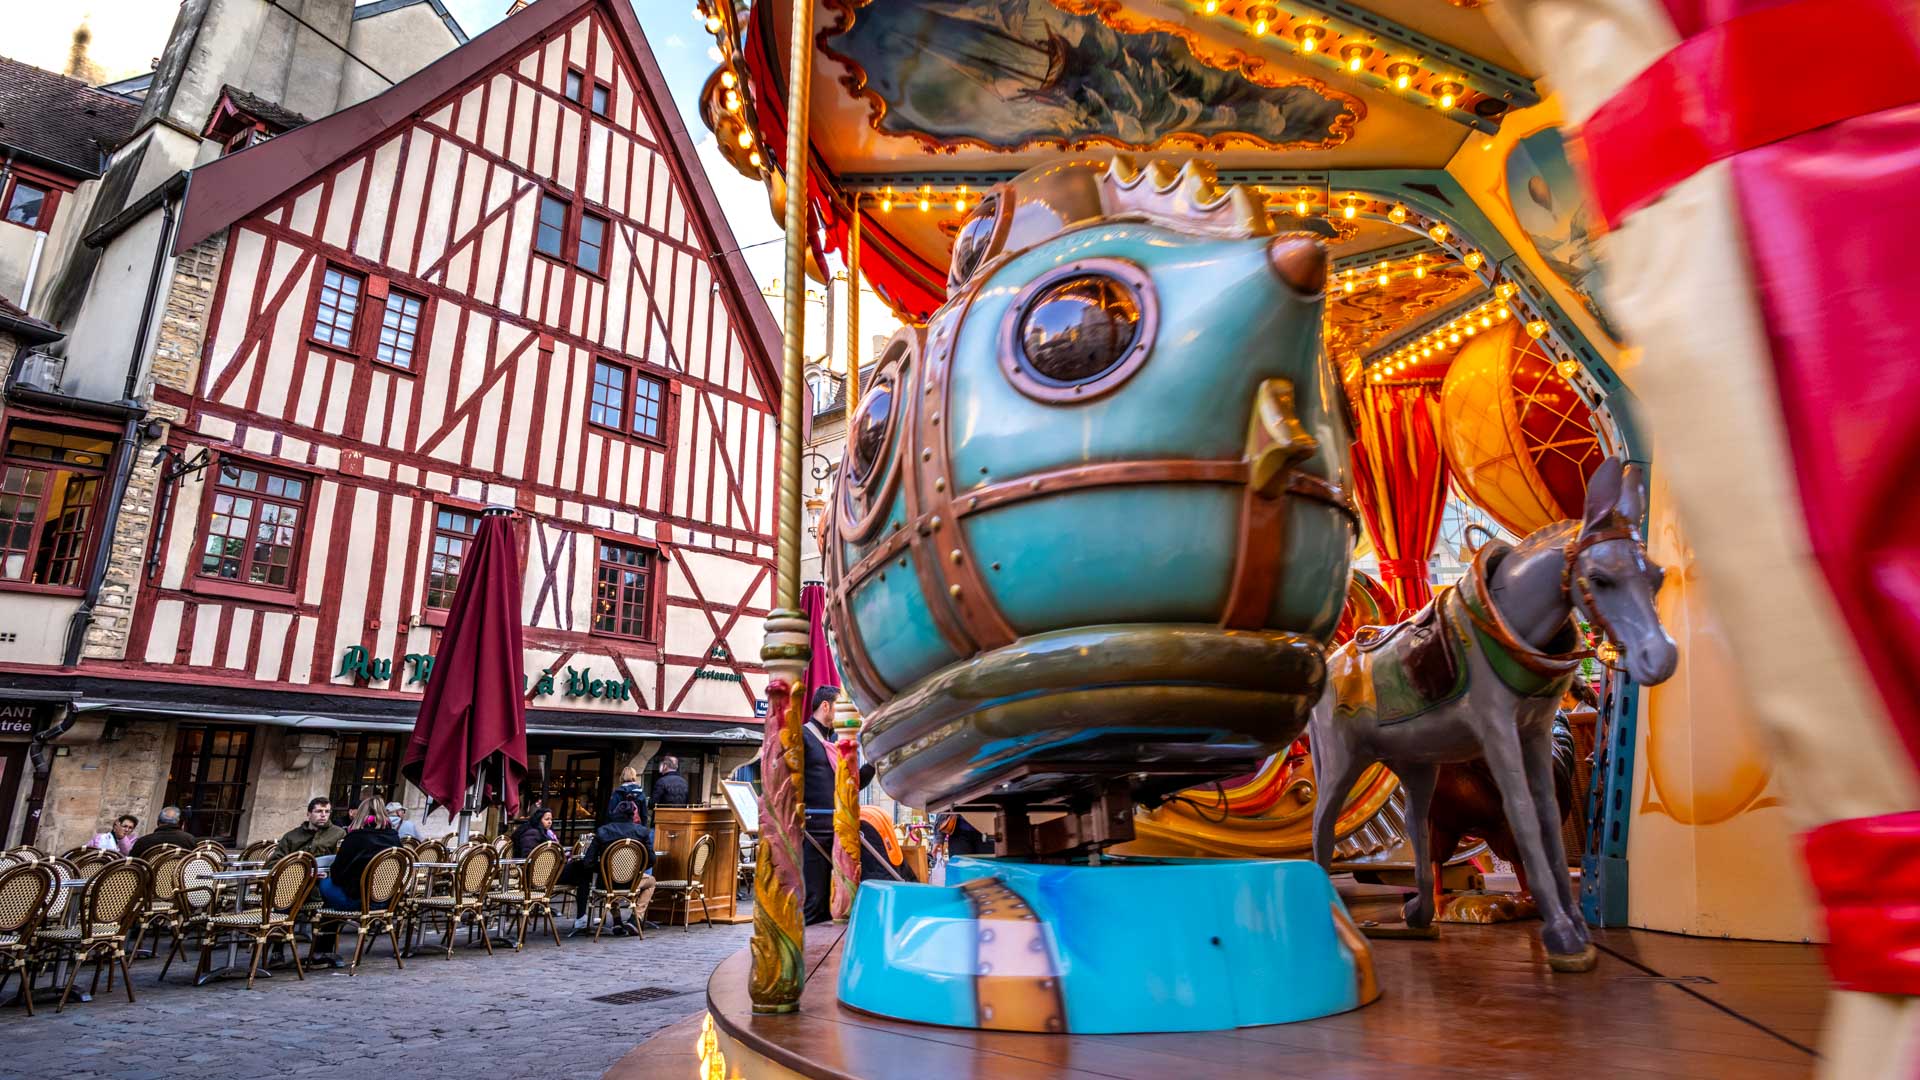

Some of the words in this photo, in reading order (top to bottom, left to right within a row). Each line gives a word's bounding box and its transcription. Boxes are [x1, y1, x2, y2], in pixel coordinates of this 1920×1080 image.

[335, 645, 392, 680] Au
[536, 668, 554, 696] à
[565, 665, 630, 701] Vent
[695, 667, 743, 683] Restaurant
[0, 706, 36, 718] ANT
[0, 720, 32, 731] trée
